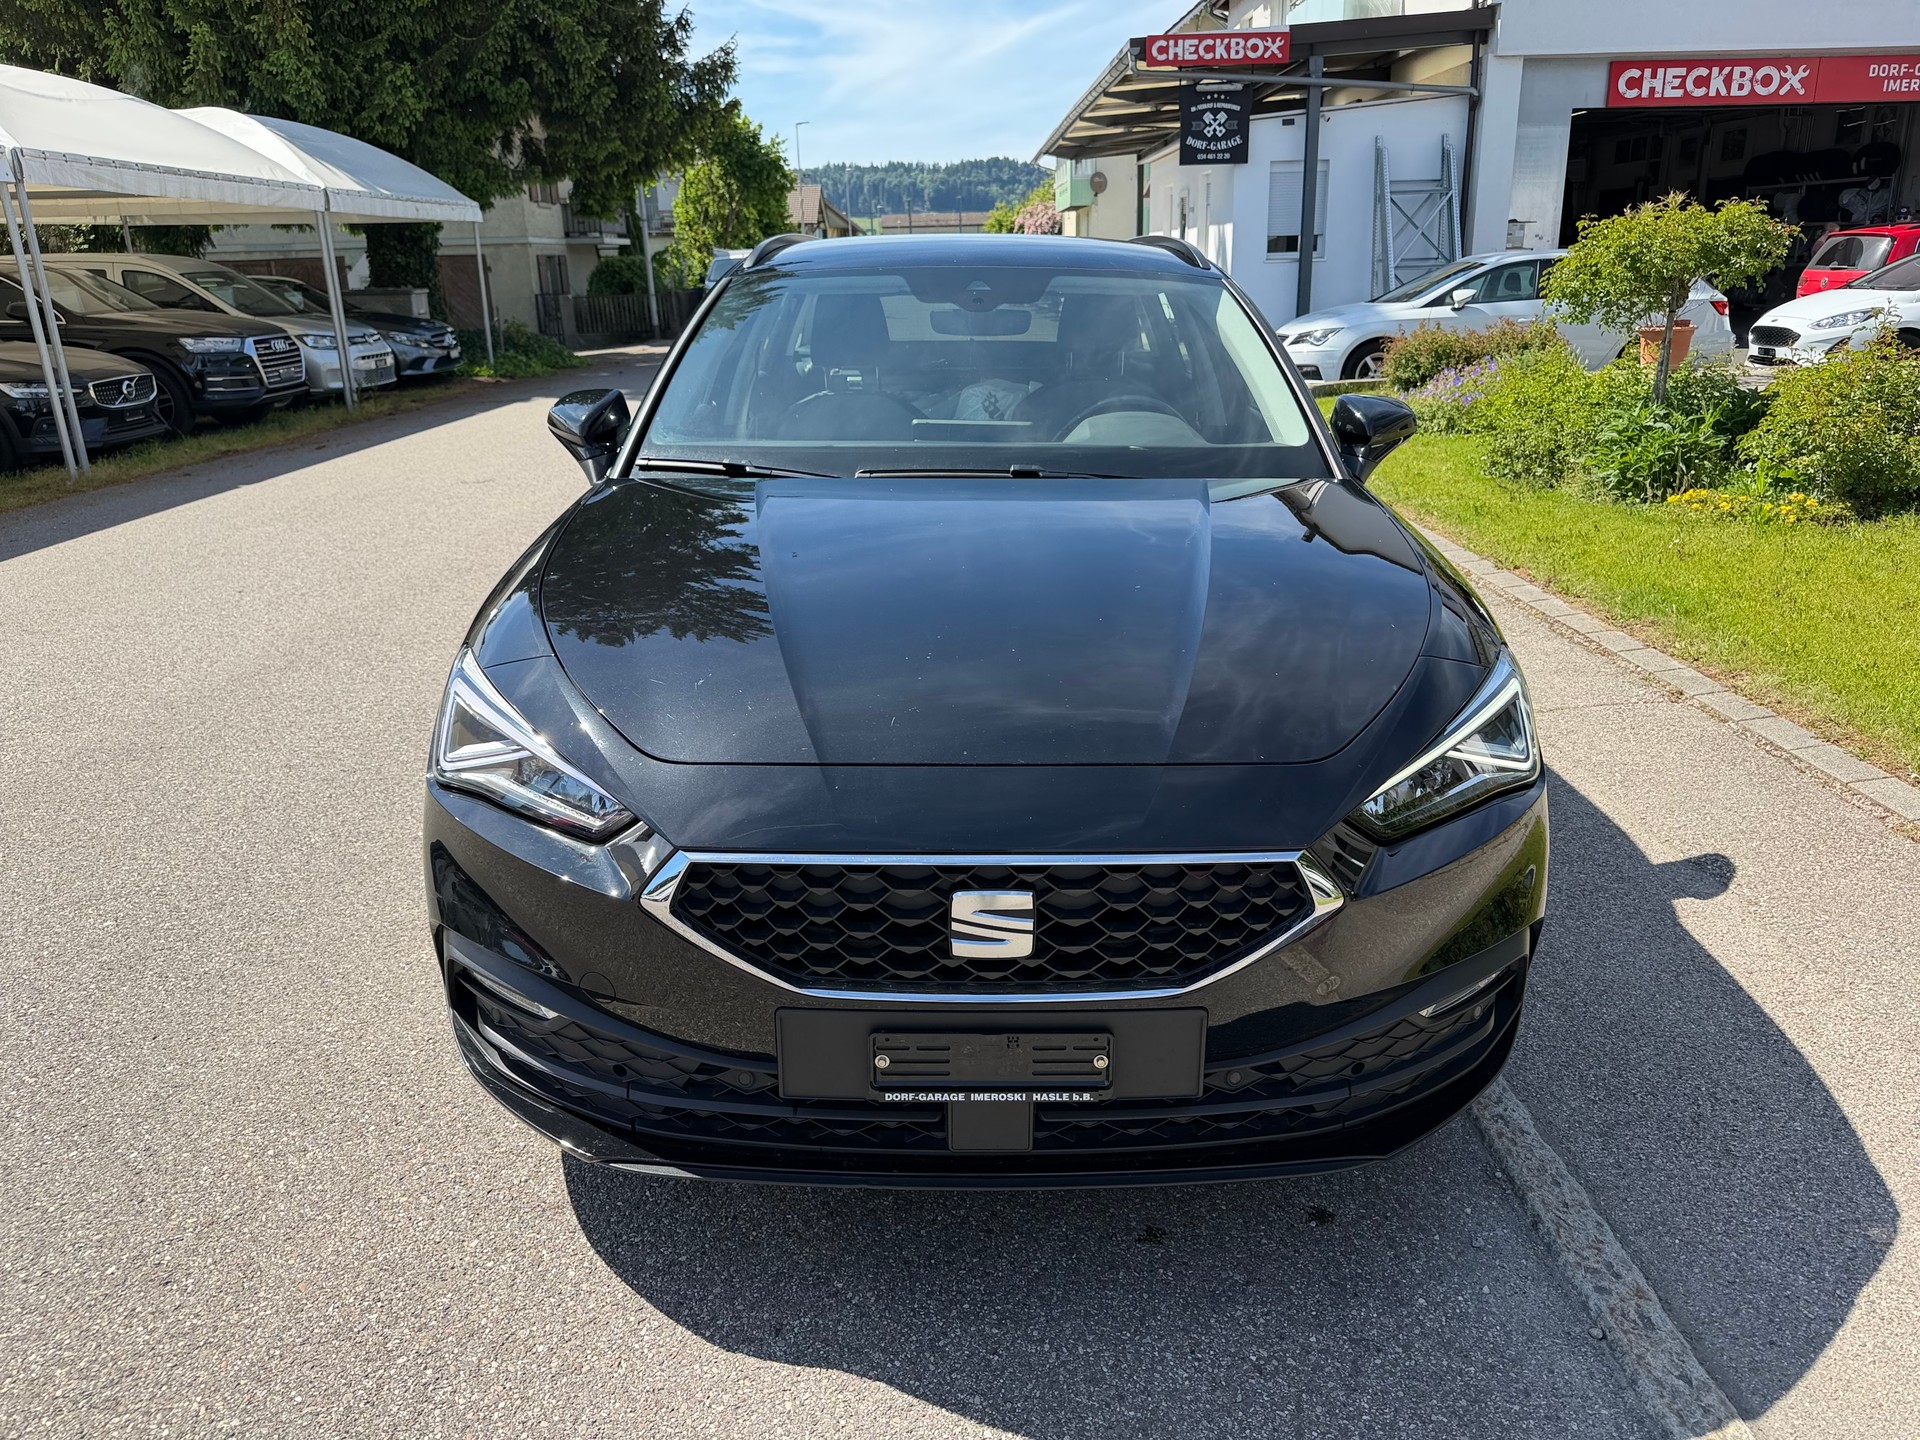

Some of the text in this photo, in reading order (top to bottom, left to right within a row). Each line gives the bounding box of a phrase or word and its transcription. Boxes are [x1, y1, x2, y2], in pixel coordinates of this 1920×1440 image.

[1151, 36, 1284, 61] CHECKBOX
[1617, 64, 1810, 99] CHECKBOX
[1185, 134, 1243, 151] DORF-GARAGE
[884, 1092, 966, 1102] DORF-GARAGE
[970, 1092, 1027, 1102] IMEROSKI
[1032, 1092, 1070, 1102] HASLE
